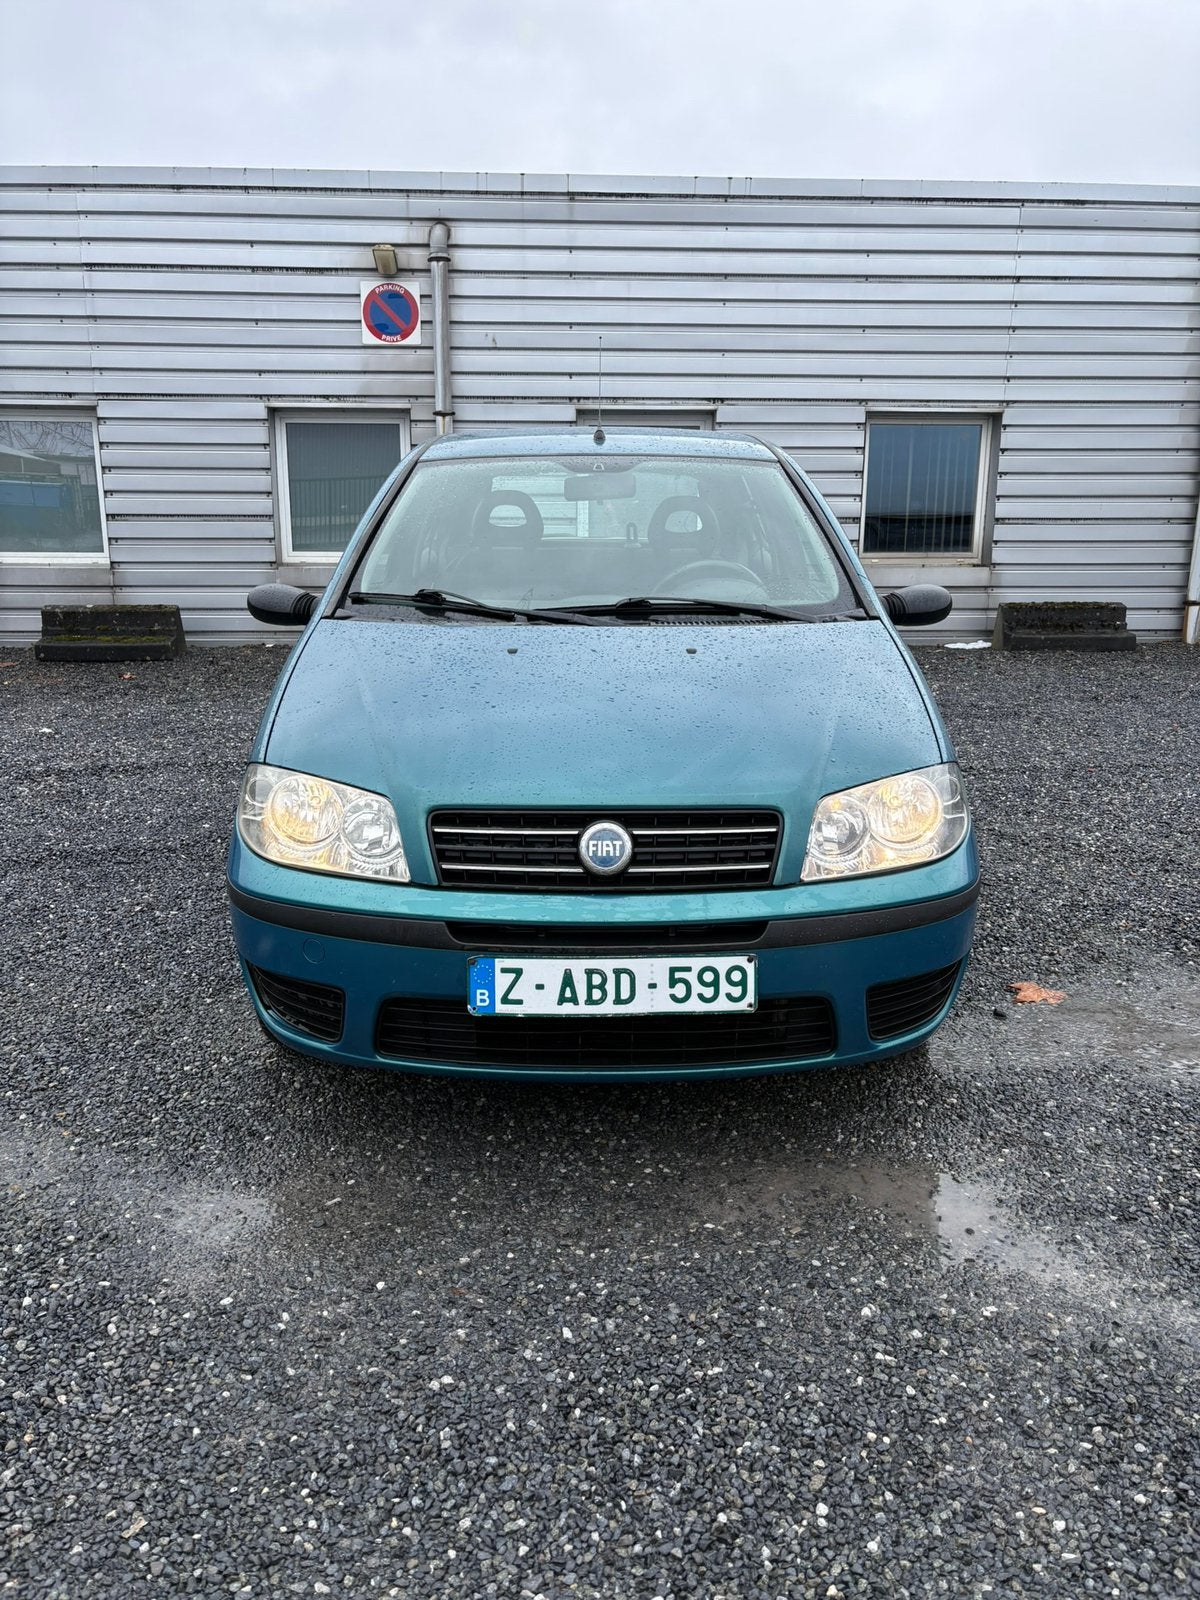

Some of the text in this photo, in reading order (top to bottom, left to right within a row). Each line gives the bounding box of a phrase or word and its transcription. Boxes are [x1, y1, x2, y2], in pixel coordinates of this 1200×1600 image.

[375, 284, 405, 294] PARKING
[588, 840, 623, 857] FIAT
[476, 990, 490, 1006] B
